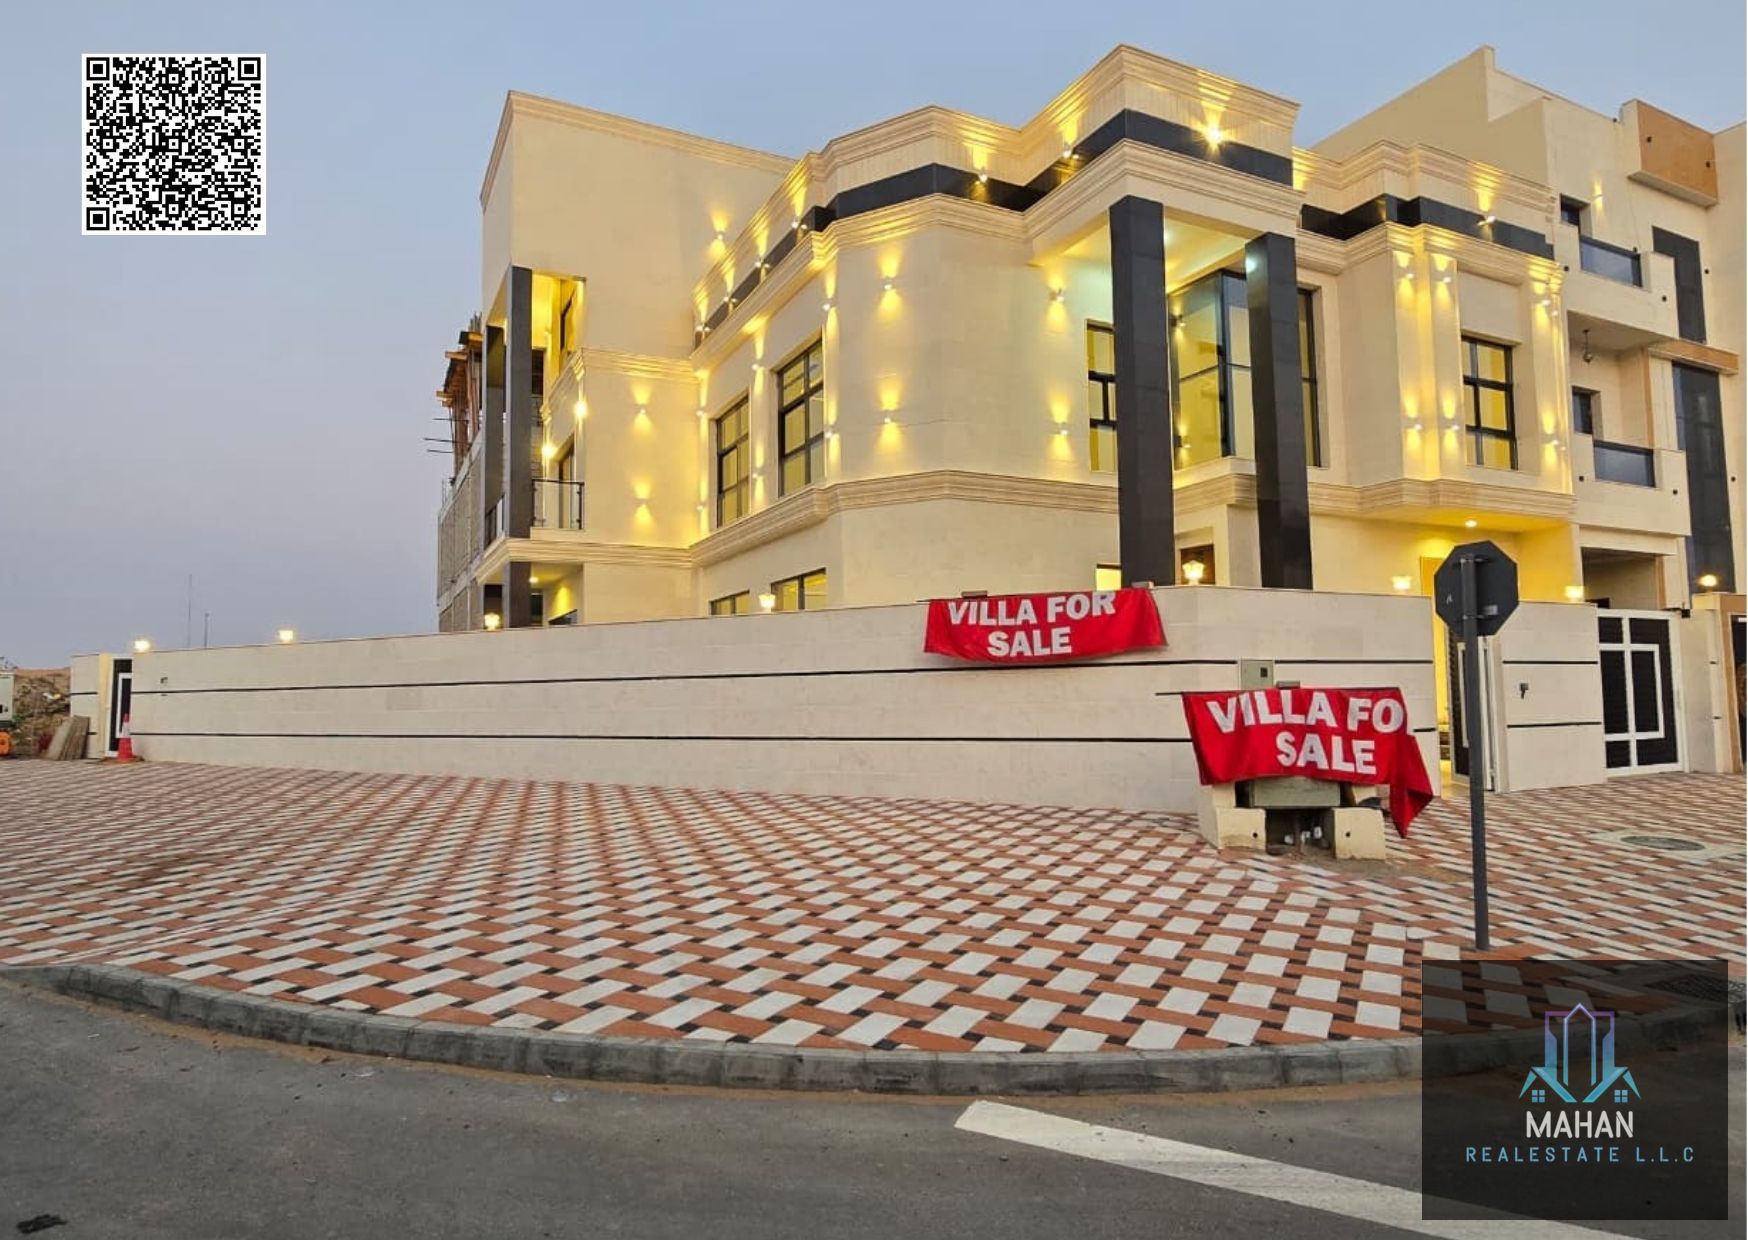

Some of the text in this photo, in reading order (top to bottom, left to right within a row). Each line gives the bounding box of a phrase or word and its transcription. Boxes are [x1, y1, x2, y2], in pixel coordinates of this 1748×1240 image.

[948, 591, 1116, 626] VILLA FOR
[987, 627, 1073, 657] SALE
[1206, 690, 1338, 734] VILLA
[1275, 731, 1377, 775] SALE
